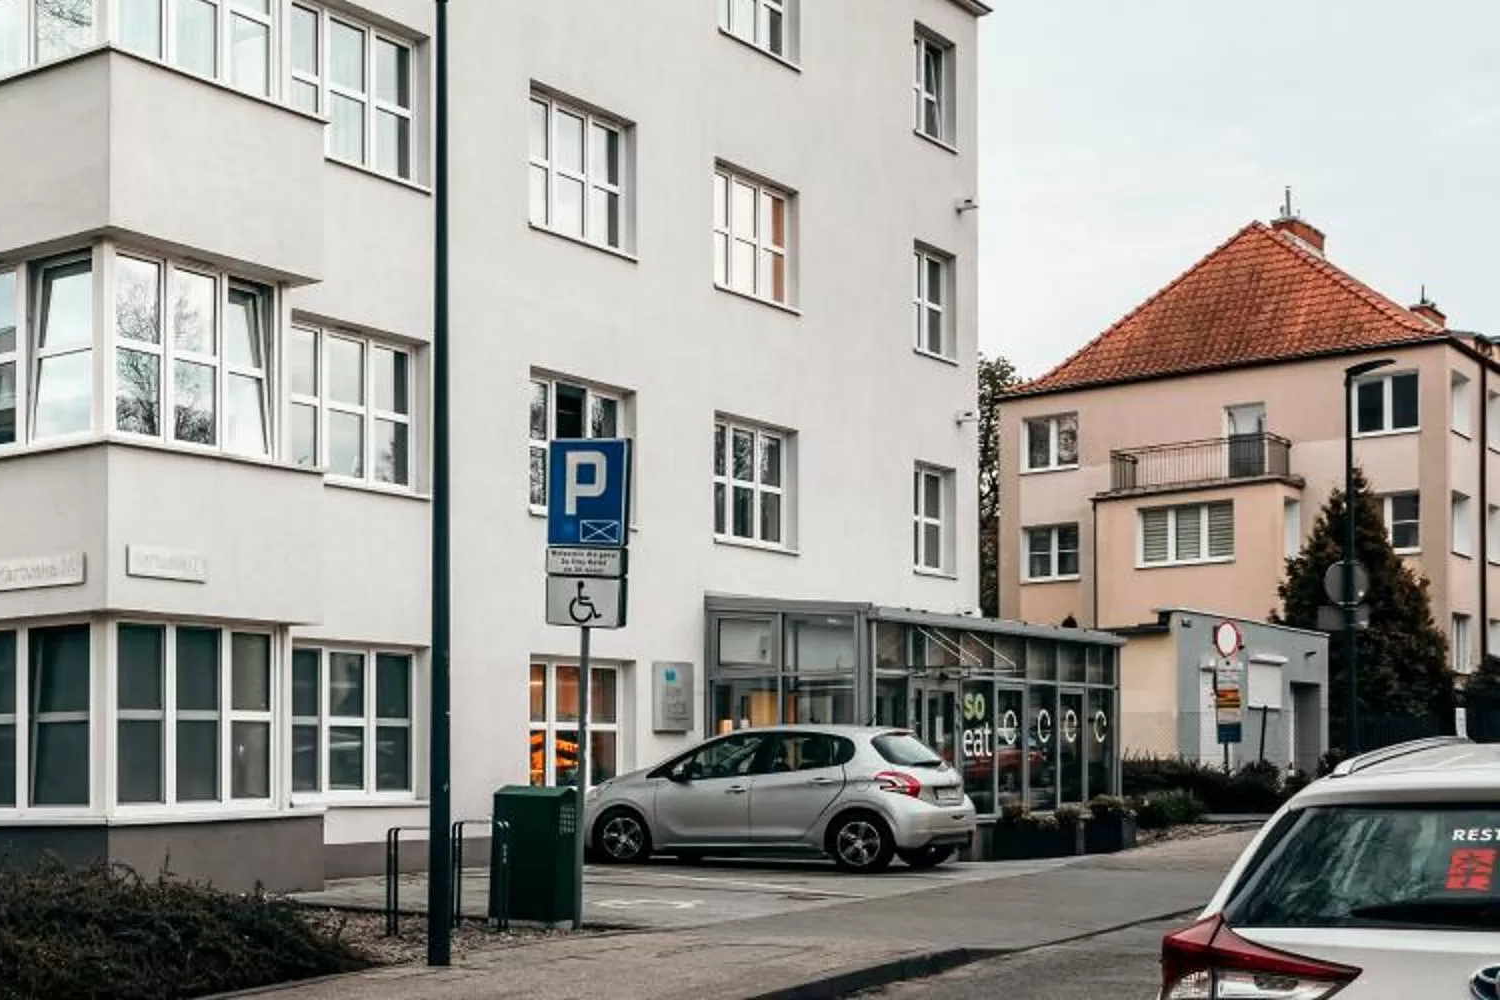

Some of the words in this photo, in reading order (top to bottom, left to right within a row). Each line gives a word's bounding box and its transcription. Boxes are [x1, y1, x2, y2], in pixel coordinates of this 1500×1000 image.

[564, 450, 607, 515] P
[964, 694, 985, 720] so
[963, 722, 993, 757] eat
